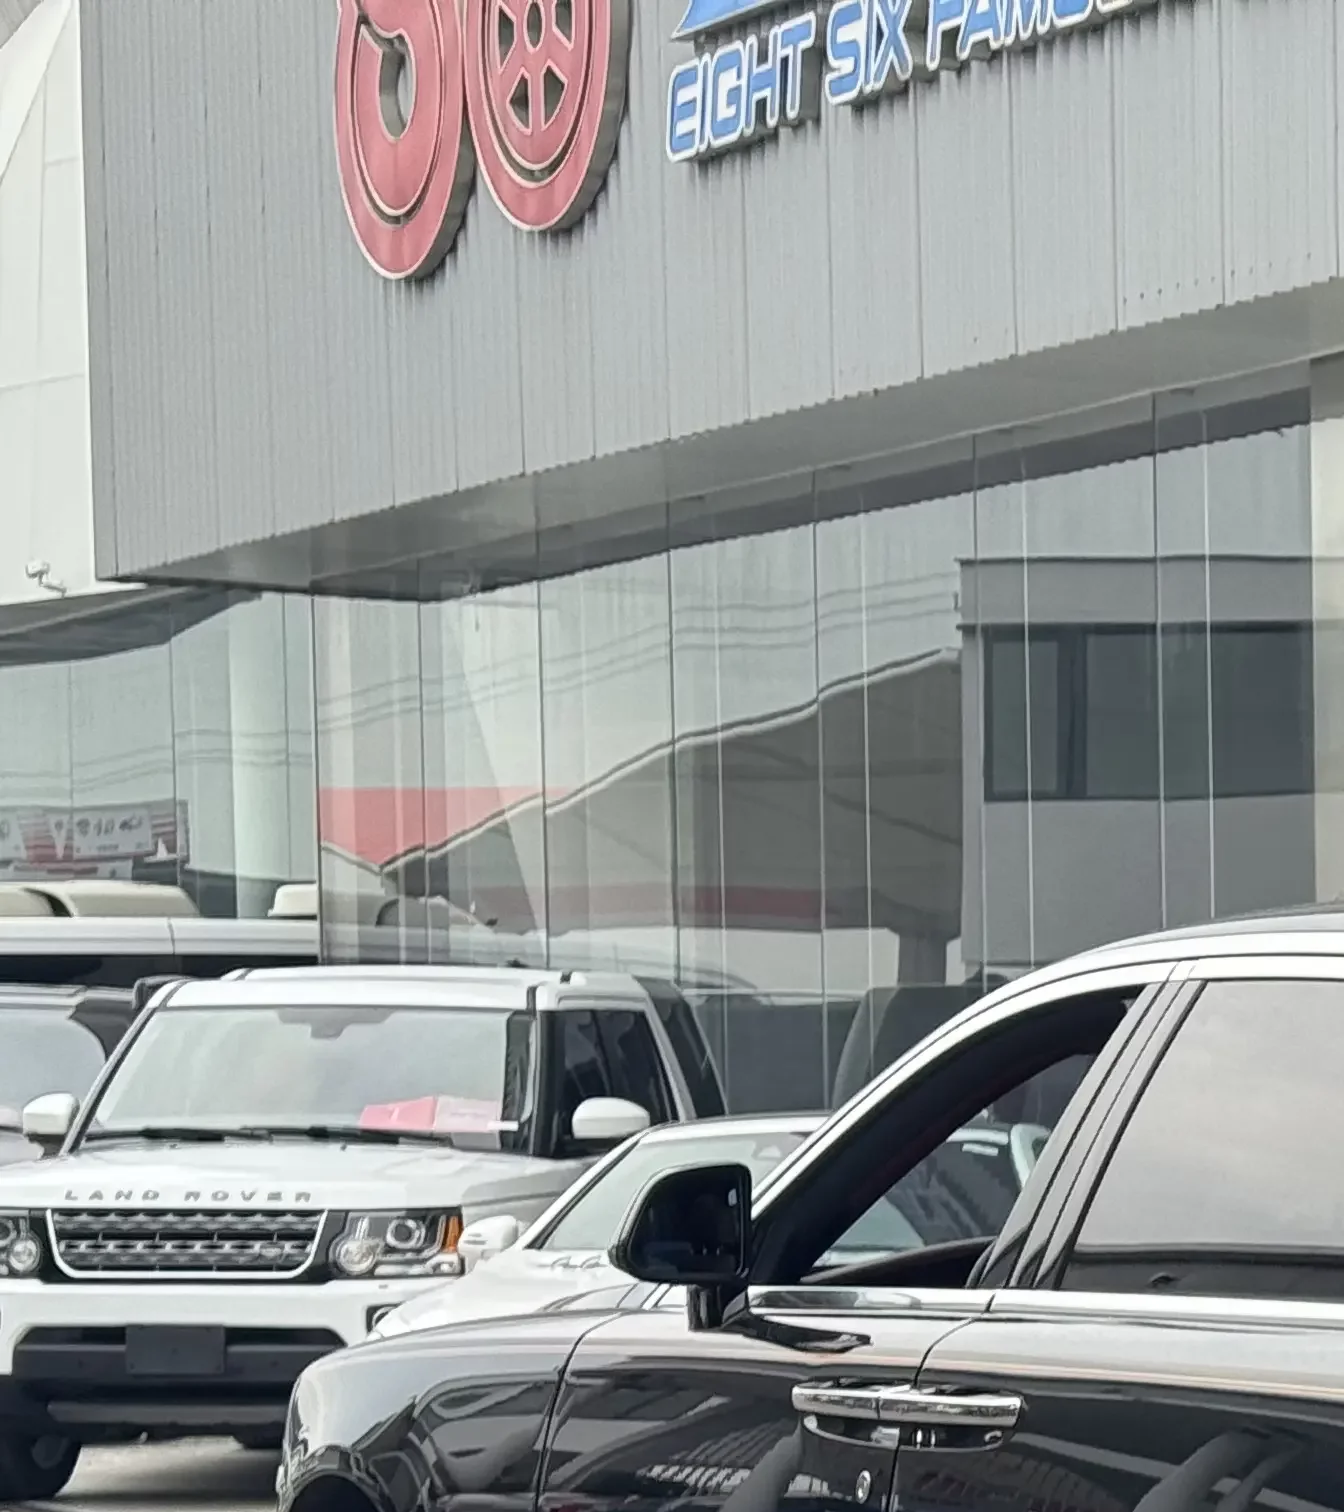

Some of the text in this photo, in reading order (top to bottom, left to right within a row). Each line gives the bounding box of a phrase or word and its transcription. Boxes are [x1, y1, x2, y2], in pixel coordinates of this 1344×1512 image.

[666, 12, 817, 162] EIGHT
[825, 0, 912, 105] SIX
[64, 1189, 312, 1203] LAND ROVER
